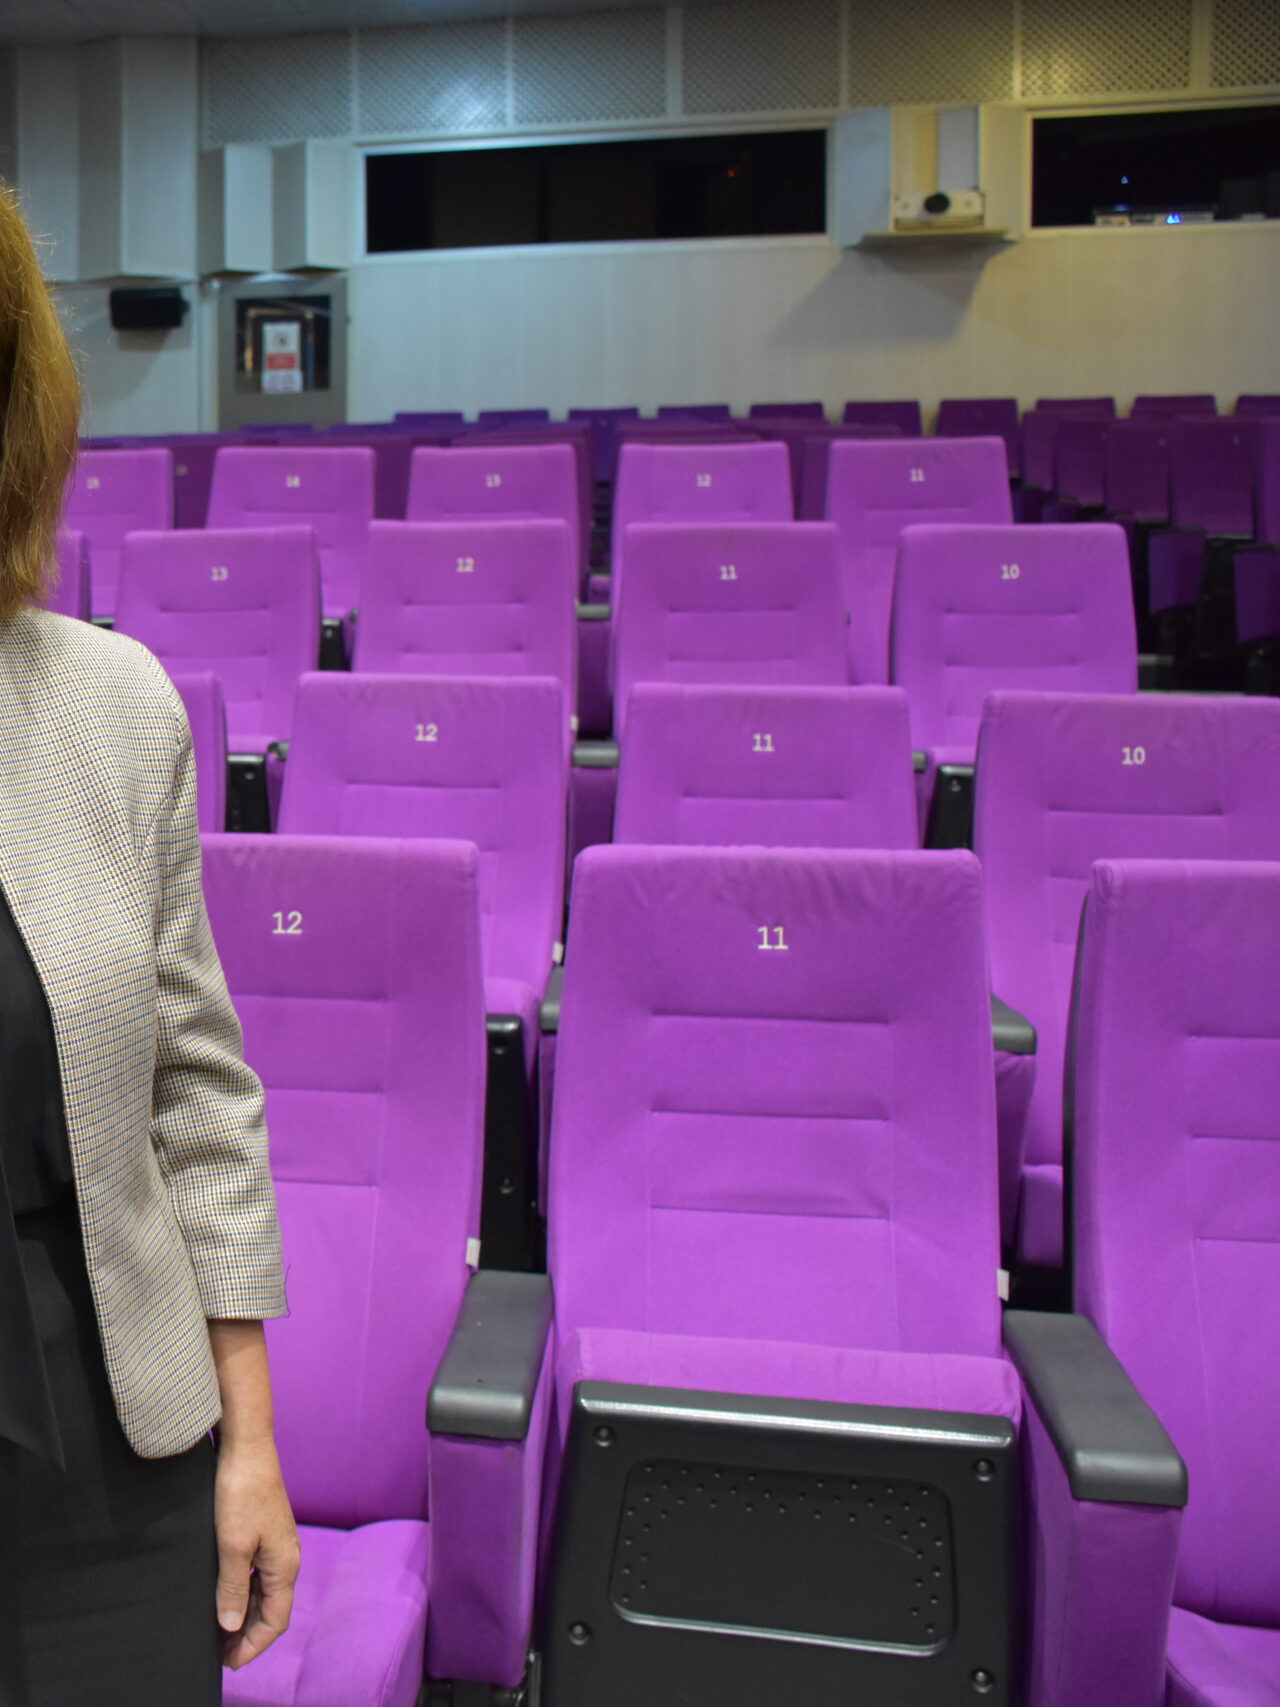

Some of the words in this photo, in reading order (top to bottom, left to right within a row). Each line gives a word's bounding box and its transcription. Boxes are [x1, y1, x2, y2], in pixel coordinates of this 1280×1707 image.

[910, 468, 926, 482] 11
[210, 566, 229, 582] 13
[456, 557, 475, 573] 12
[720, 564, 738, 581] 11
[1001, 563, 1020, 580] 10
[415, 723, 438, 742] 12
[752, 733, 775, 753] 11
[1121, 746, 1146, 765] 10
[272, 910, 303, 935] 12
[757, 926, 789, 950] 11
